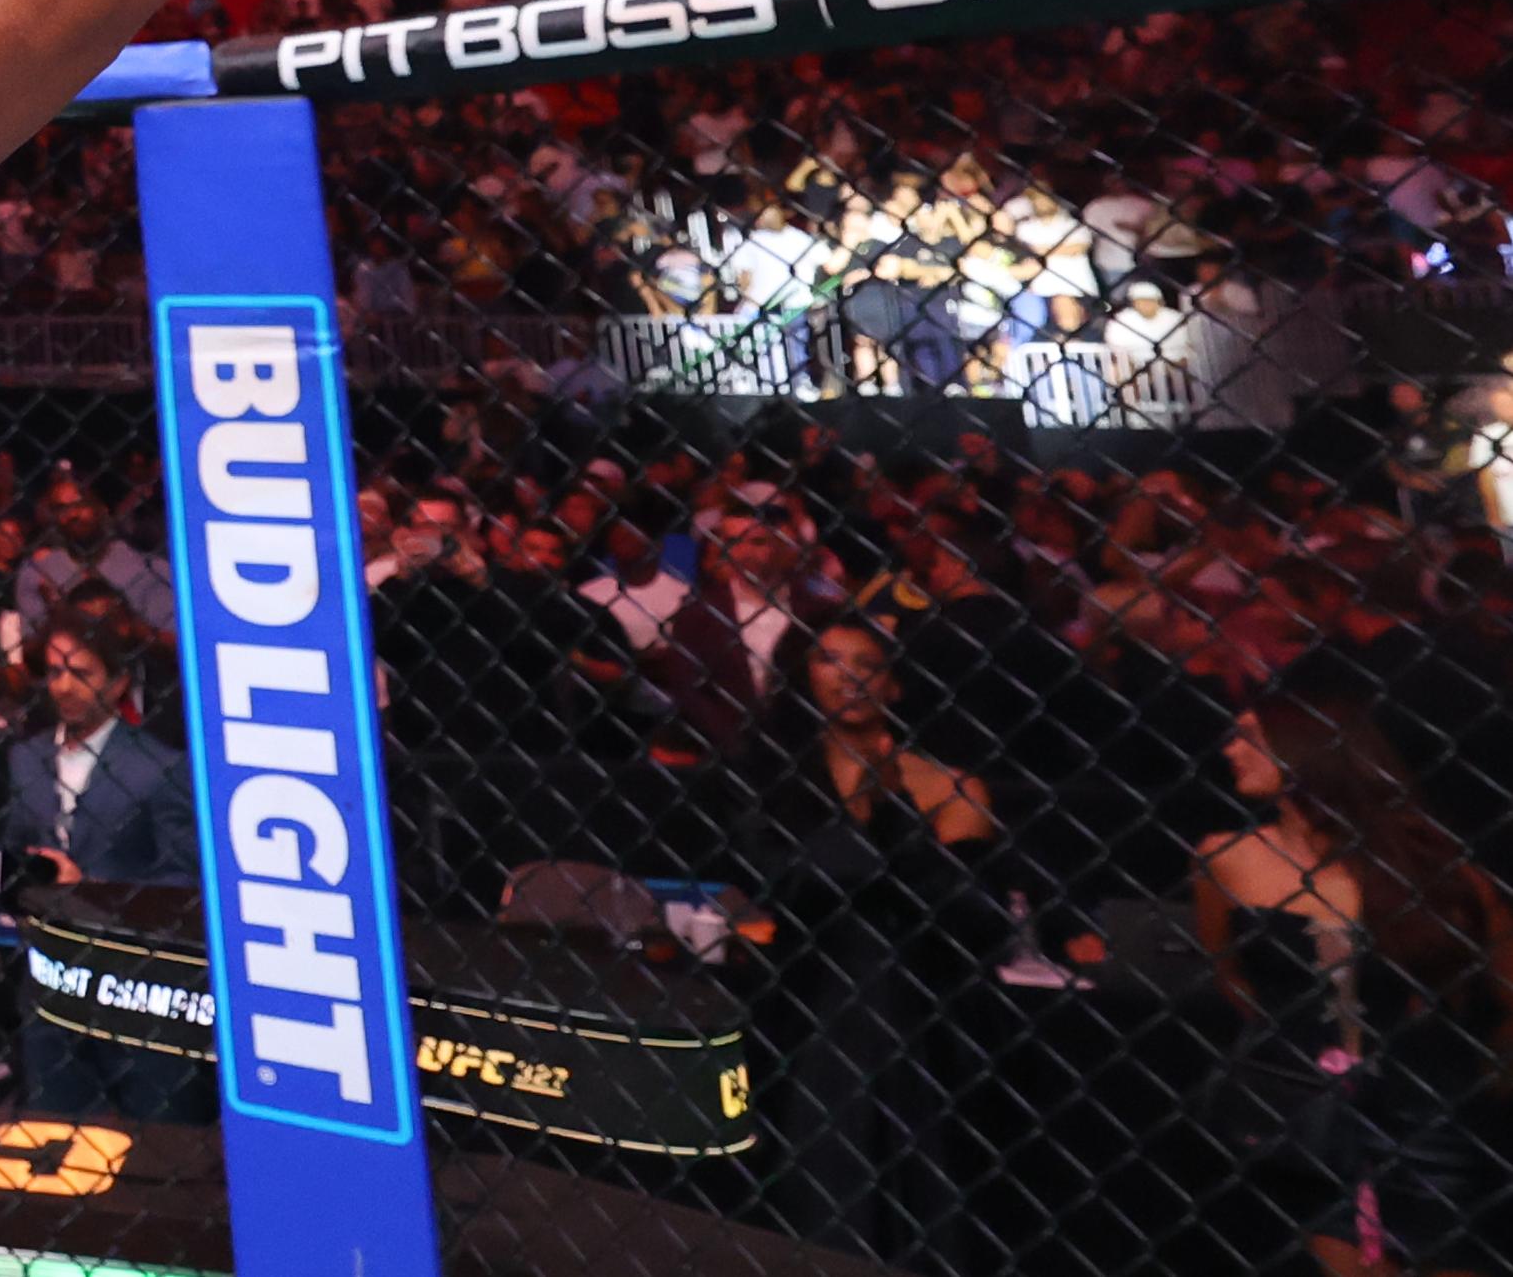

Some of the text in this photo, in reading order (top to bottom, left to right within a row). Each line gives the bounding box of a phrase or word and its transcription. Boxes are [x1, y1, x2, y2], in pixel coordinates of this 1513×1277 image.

[277, 16, 437, 90] PIT
[188, 324, 373, 1105] BUD LIGHT
[416, 1035, 516, 1086] UFC
